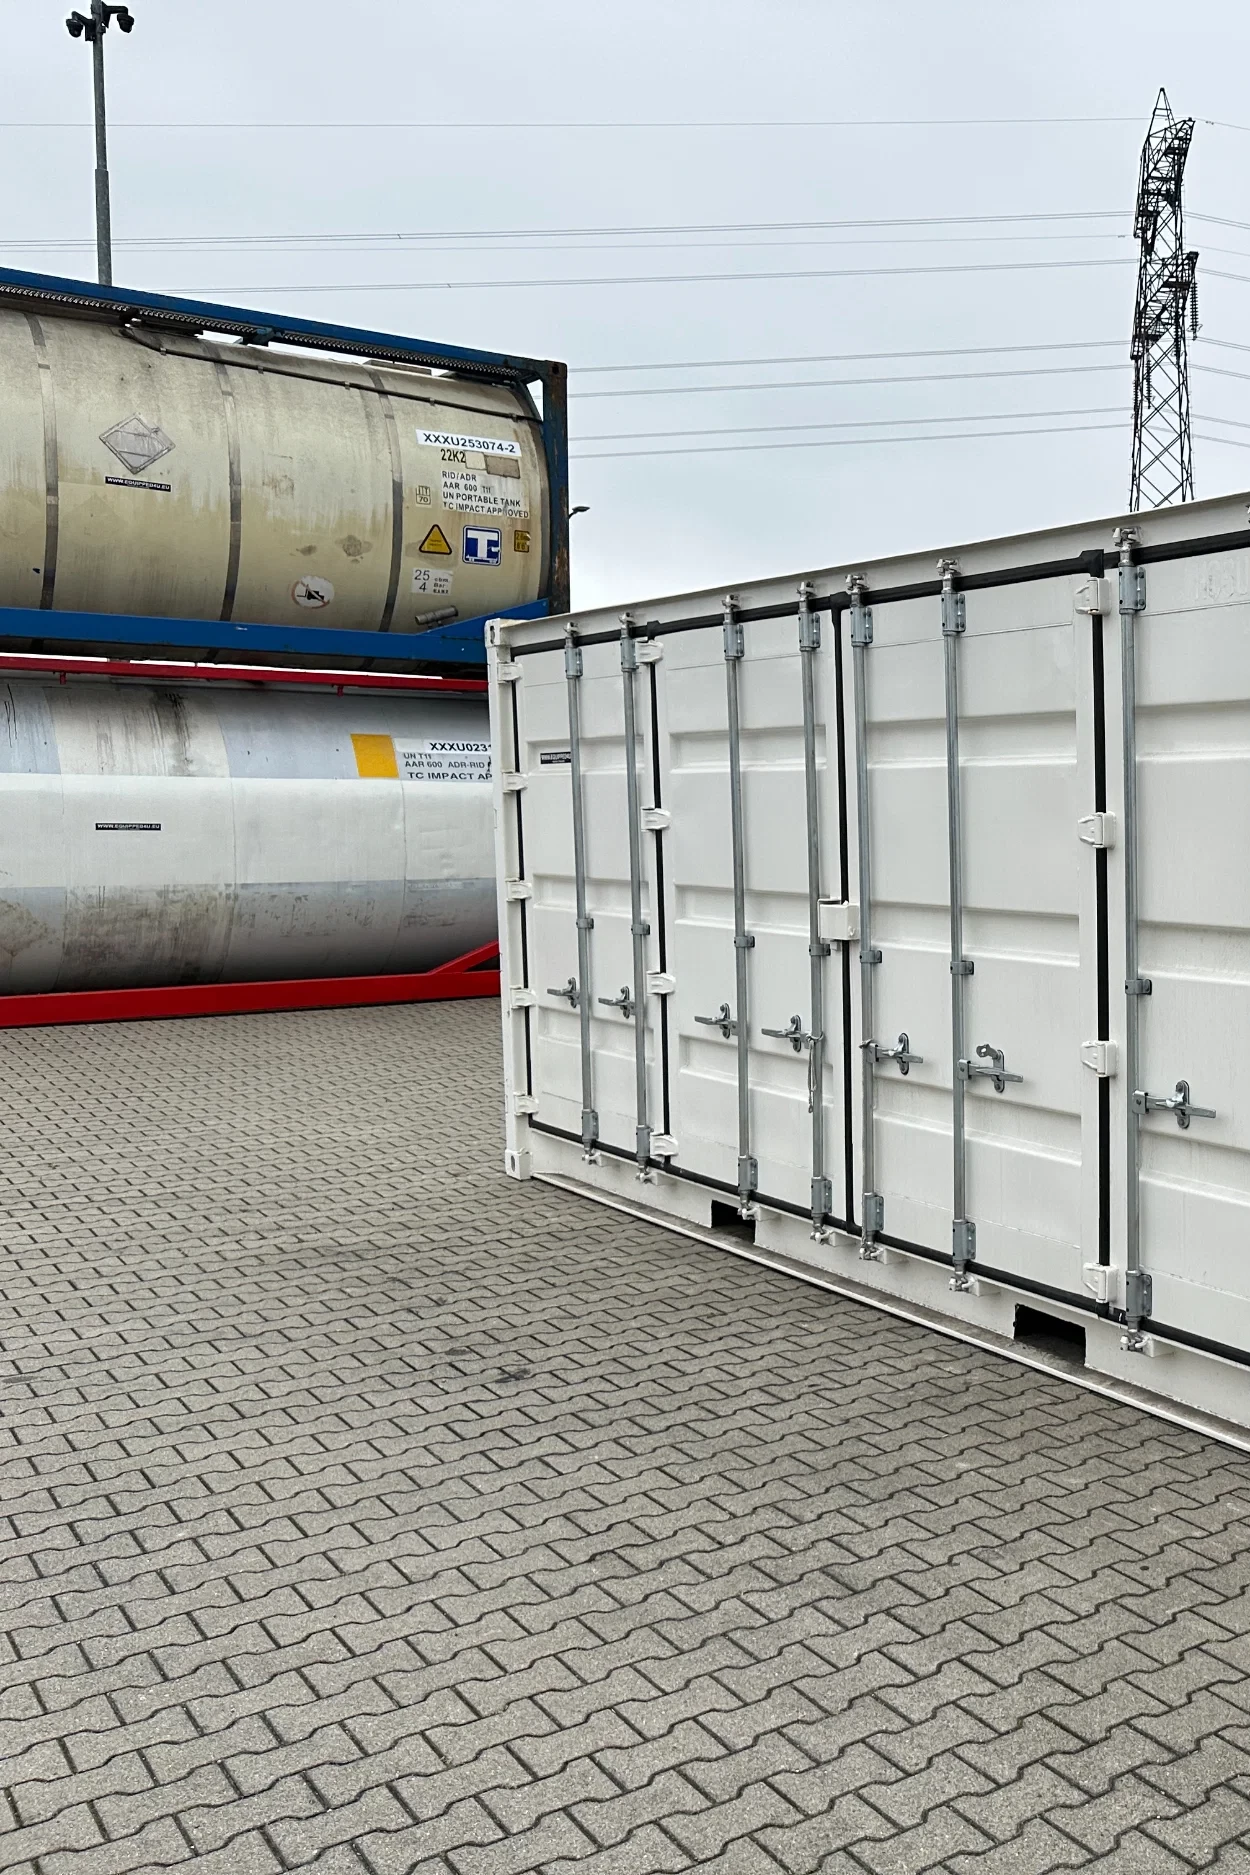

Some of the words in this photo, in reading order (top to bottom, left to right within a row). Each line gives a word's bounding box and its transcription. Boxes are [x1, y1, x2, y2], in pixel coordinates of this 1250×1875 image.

[423, 432, 516, 453] XXXU253074-2
[440, 448, 466, 463] 22K2
[443, 481, 460, 490] AAR
[464, 483, 478, 492] 600
[442, 491, 454, 500] UN
[456, 493, 501, 505] PORTABLE
[501, 497, 521, 508] TANK
[456, 502, 485, 513] IMPACT
[487, 507, 529, 519] APPOVED
[414, 569, 430, 581] 25
[419, 582, 427, 593] 4
[448, 761, 486, 769] ADR-RID
[428, 772, 474, 780] IMPACT
